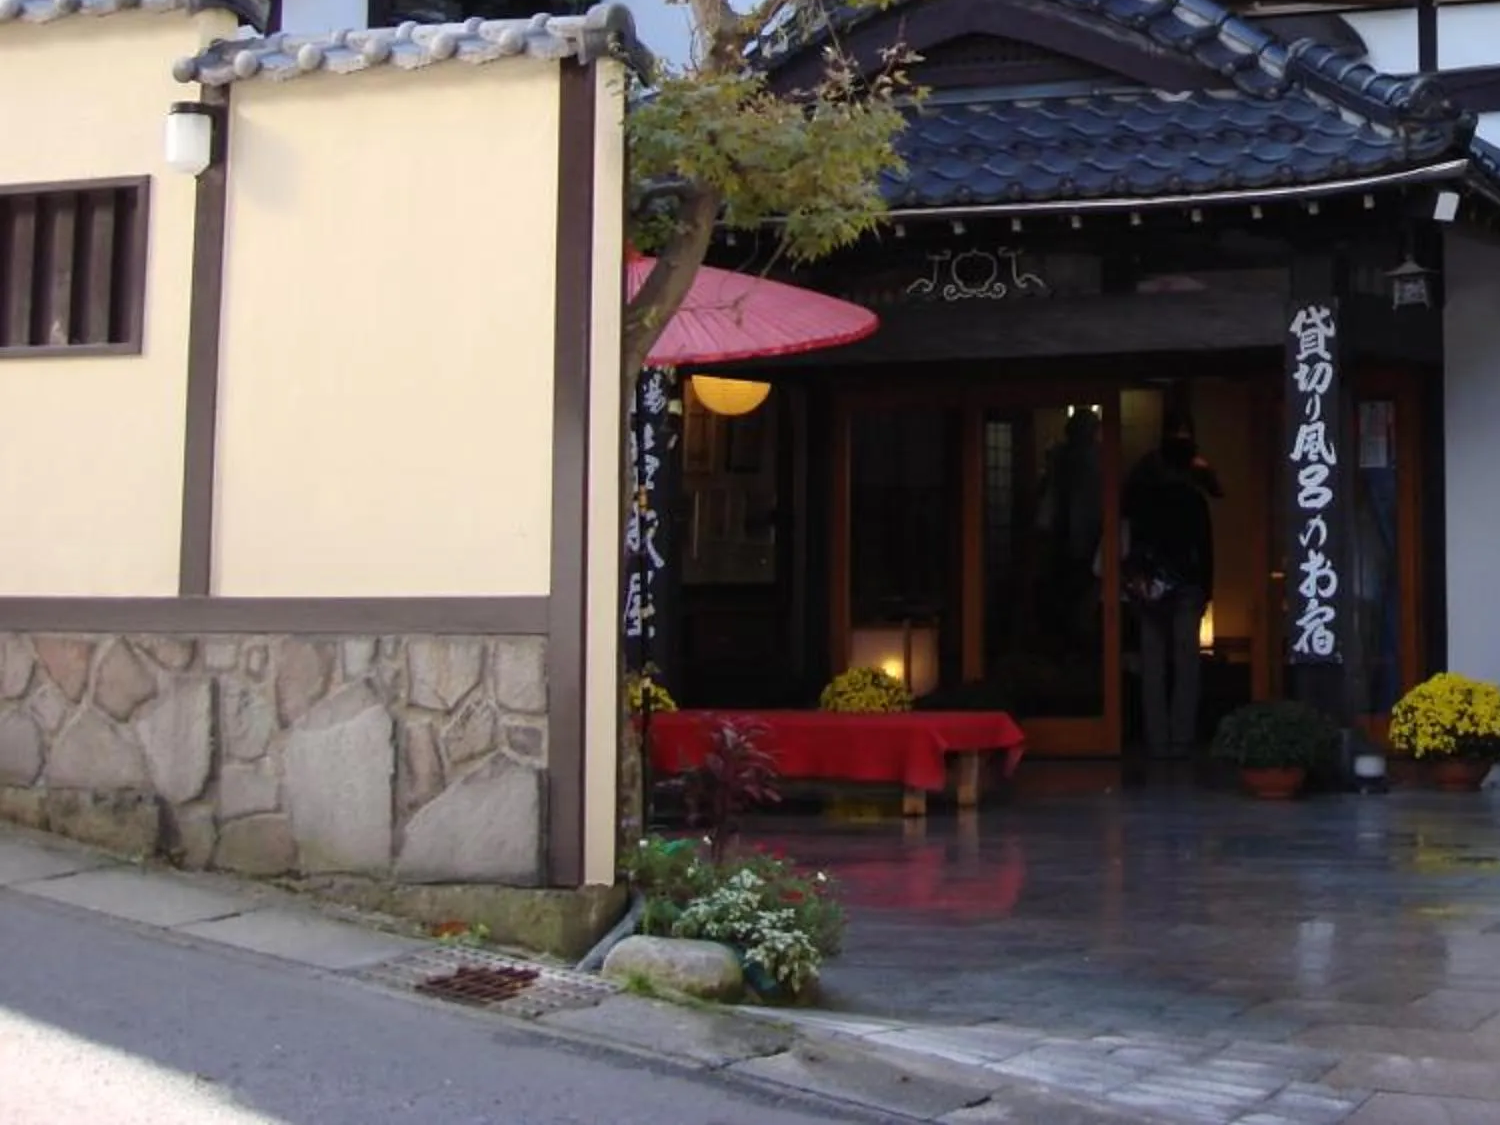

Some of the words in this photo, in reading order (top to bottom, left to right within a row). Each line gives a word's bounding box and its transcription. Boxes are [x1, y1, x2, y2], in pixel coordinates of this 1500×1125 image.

[1289, 305, 1338, 656] 貸切り風呂のお宿
